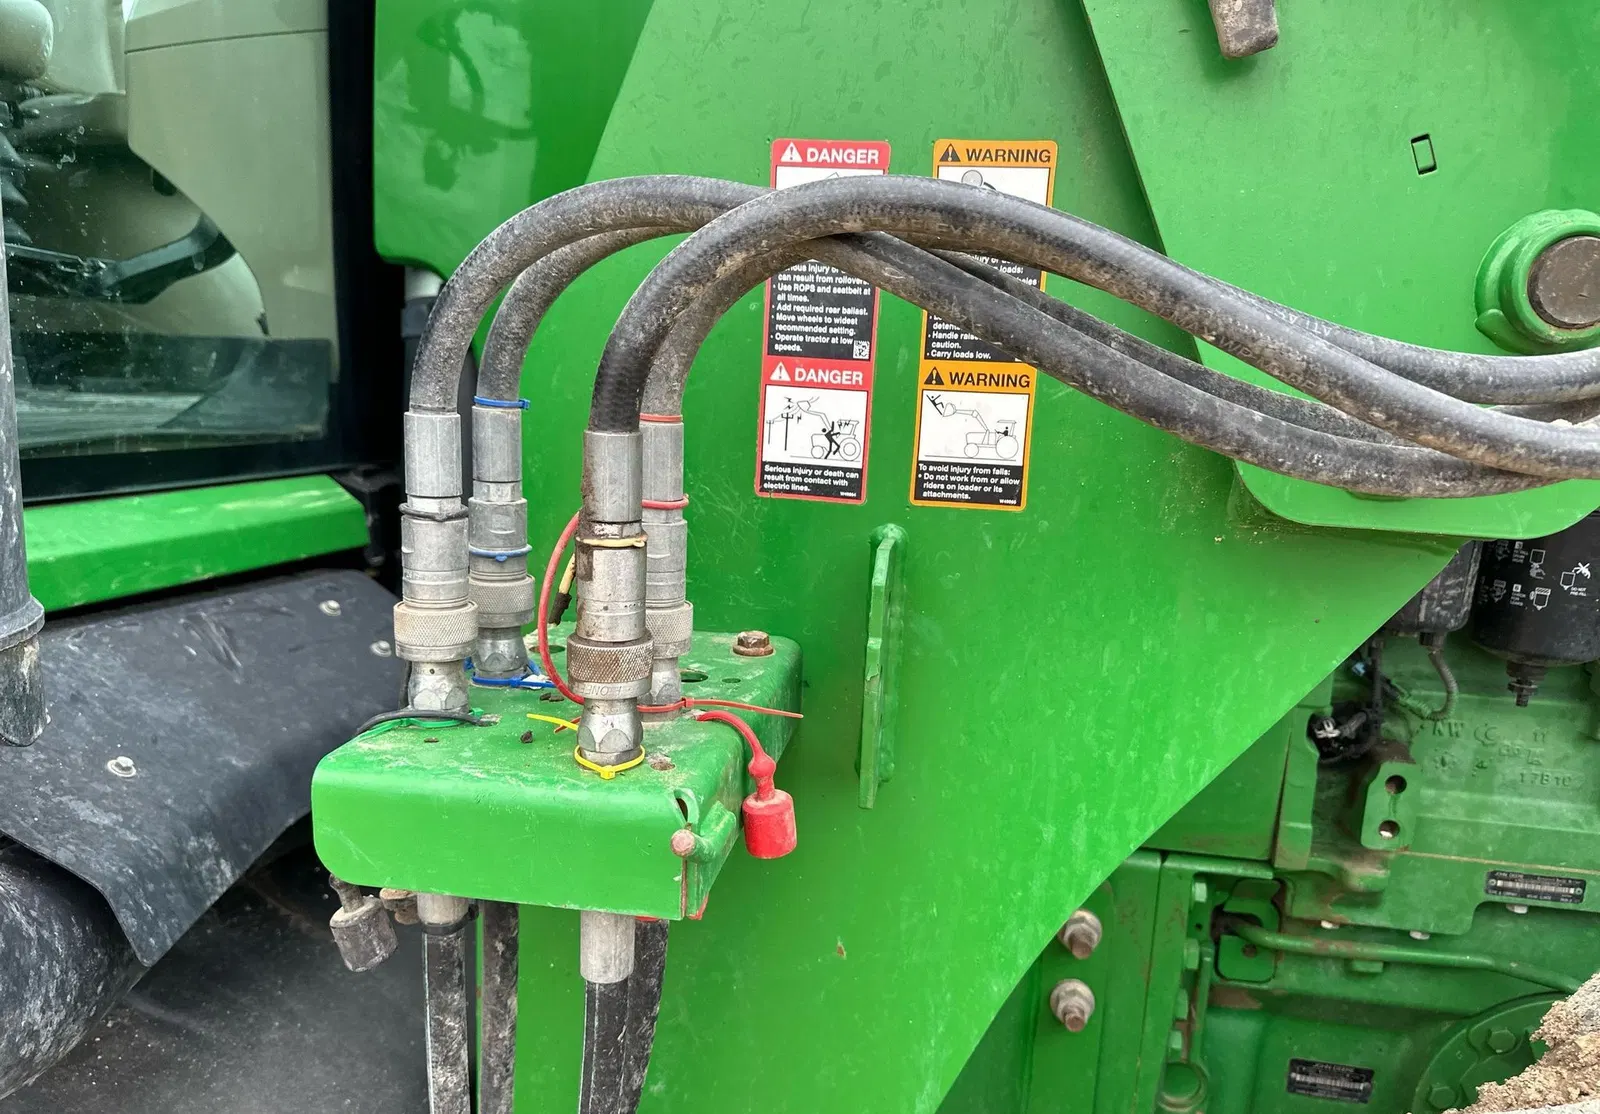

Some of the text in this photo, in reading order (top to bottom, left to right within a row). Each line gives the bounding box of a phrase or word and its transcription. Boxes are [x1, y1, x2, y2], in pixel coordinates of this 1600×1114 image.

[806, 148, 879, 165] DANGER
[965, 148, 1050, 163] WARNING
[808, 263, 830, 274] injury
[793, 274, 814, 282] result
[816, 275, 834, 284] from
[778, 283, 792, 292] Use
[794, 284, 816, 292] ROPS
[816, 285, 831, 293] and
[832, 286, 862, 295] seatbelt
[788, 294, 809, 302] times.
[776, 303, 792, 312] Add
[793, 304, 824, 314] required
[842, 306, 868, 316] ballast.
[776, 313, 858, 325] Move wheels to widest
[776, 324, 856, 336] recommended setting.
[932, 330, 958, 340] Handle
[775, 333, 804, 342] Operate
[805, 334, 829, 343] tractor
[840, 336, 853, 344] low
[774, 343, 802, 352] speeds.
[932, 341, 962, 349] caution.
[930, 349, 992, 359] Carry loads low.
[794, 368, 863, 386] DANGER
[949, 372, 1030, 388] WARNING
[764, 464, 791, 474] Serious
[792, 466, 812, 476] injury
[824, 469, 844, 478] death
[928, 464, 948, 472] avoid
[950, 465, 972, 474] injury
[992, 468, 1010, 476] falls:
[764, 474, 784, 482] result
[804, 476, 832, 485] contact
[833, 478, 848, 486] with
[950, 474, 968, 482] work
[1000, 477, 1020, 485] allow
[764, 482, 810, 492] electric lines.
[923, 482, 944, 490] riders
[958, 484, 982, 492] loader
[922, 490, 971, 500] attachments.
